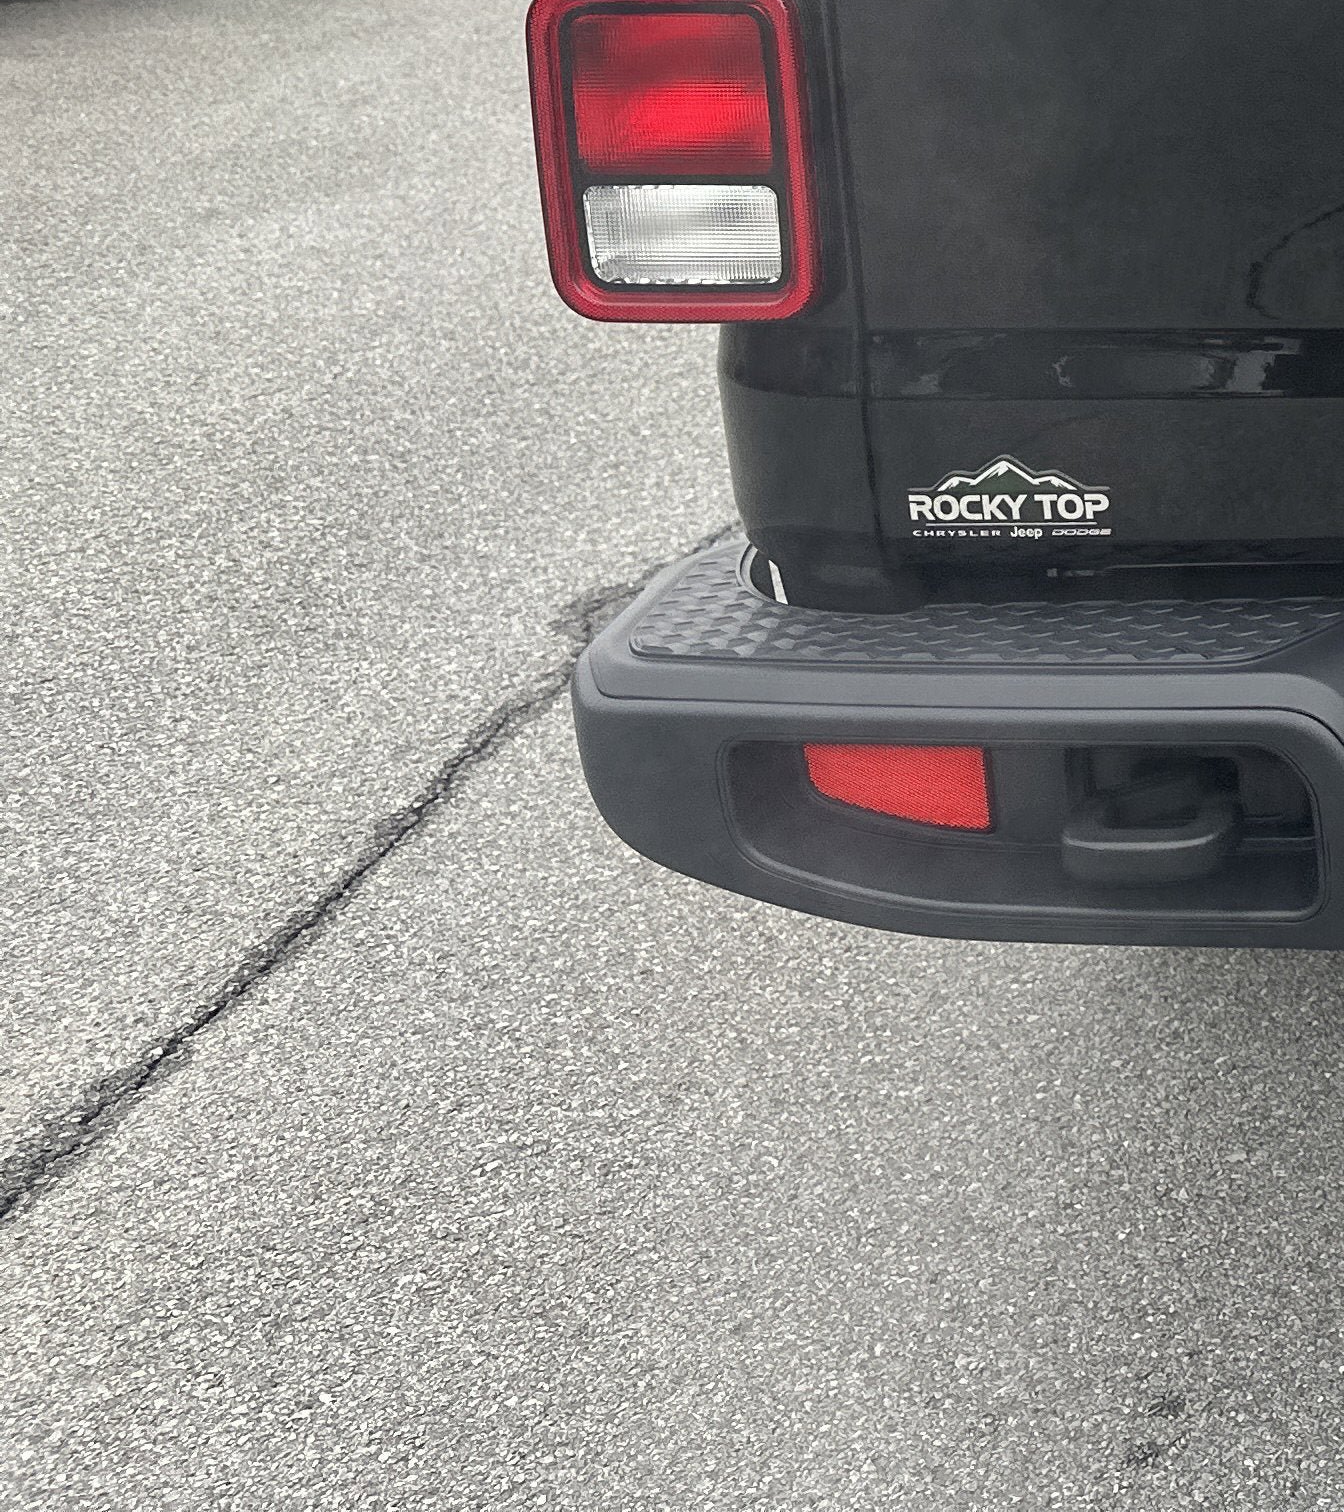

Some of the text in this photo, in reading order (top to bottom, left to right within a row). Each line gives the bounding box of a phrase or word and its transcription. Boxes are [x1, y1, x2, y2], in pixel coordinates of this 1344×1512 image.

[908, 493, 1110, 521] ROCKY TOP
[912, 525, 1112, 540] CHRYSLER Jeep DODGE
